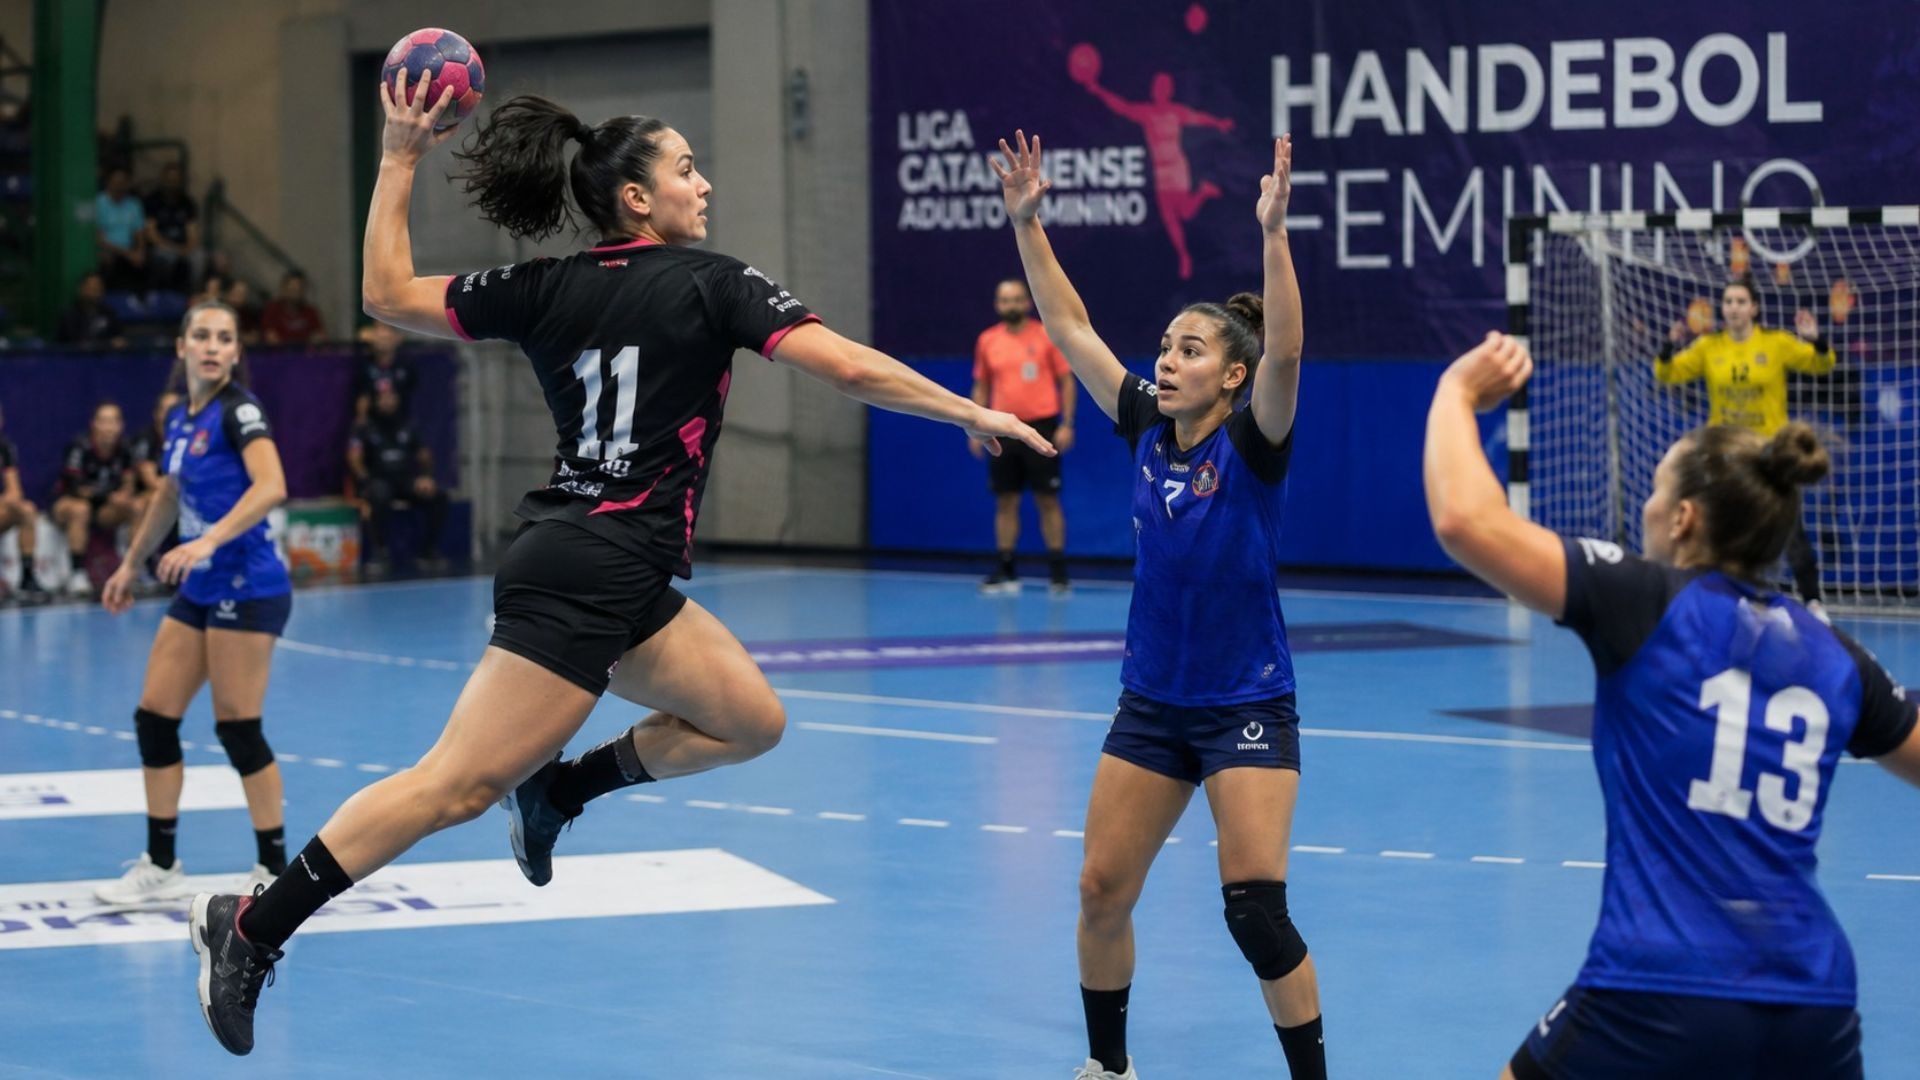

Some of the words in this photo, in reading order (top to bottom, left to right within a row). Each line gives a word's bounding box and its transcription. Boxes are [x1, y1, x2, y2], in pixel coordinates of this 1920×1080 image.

[1271, 32, 1823, 138] HANDEBOL
[898, 110, 974, 149] LIGA
[898, 147, 1147, 193] CATAENSE
[899, 197, 1007, 230] ADULTO
[1040, 191, 1147, 228] MININO
[572, 345, 640, 460] 11
[1163, 479, 1186, 519] 7
[1687, 667, 1829, 832] 13
